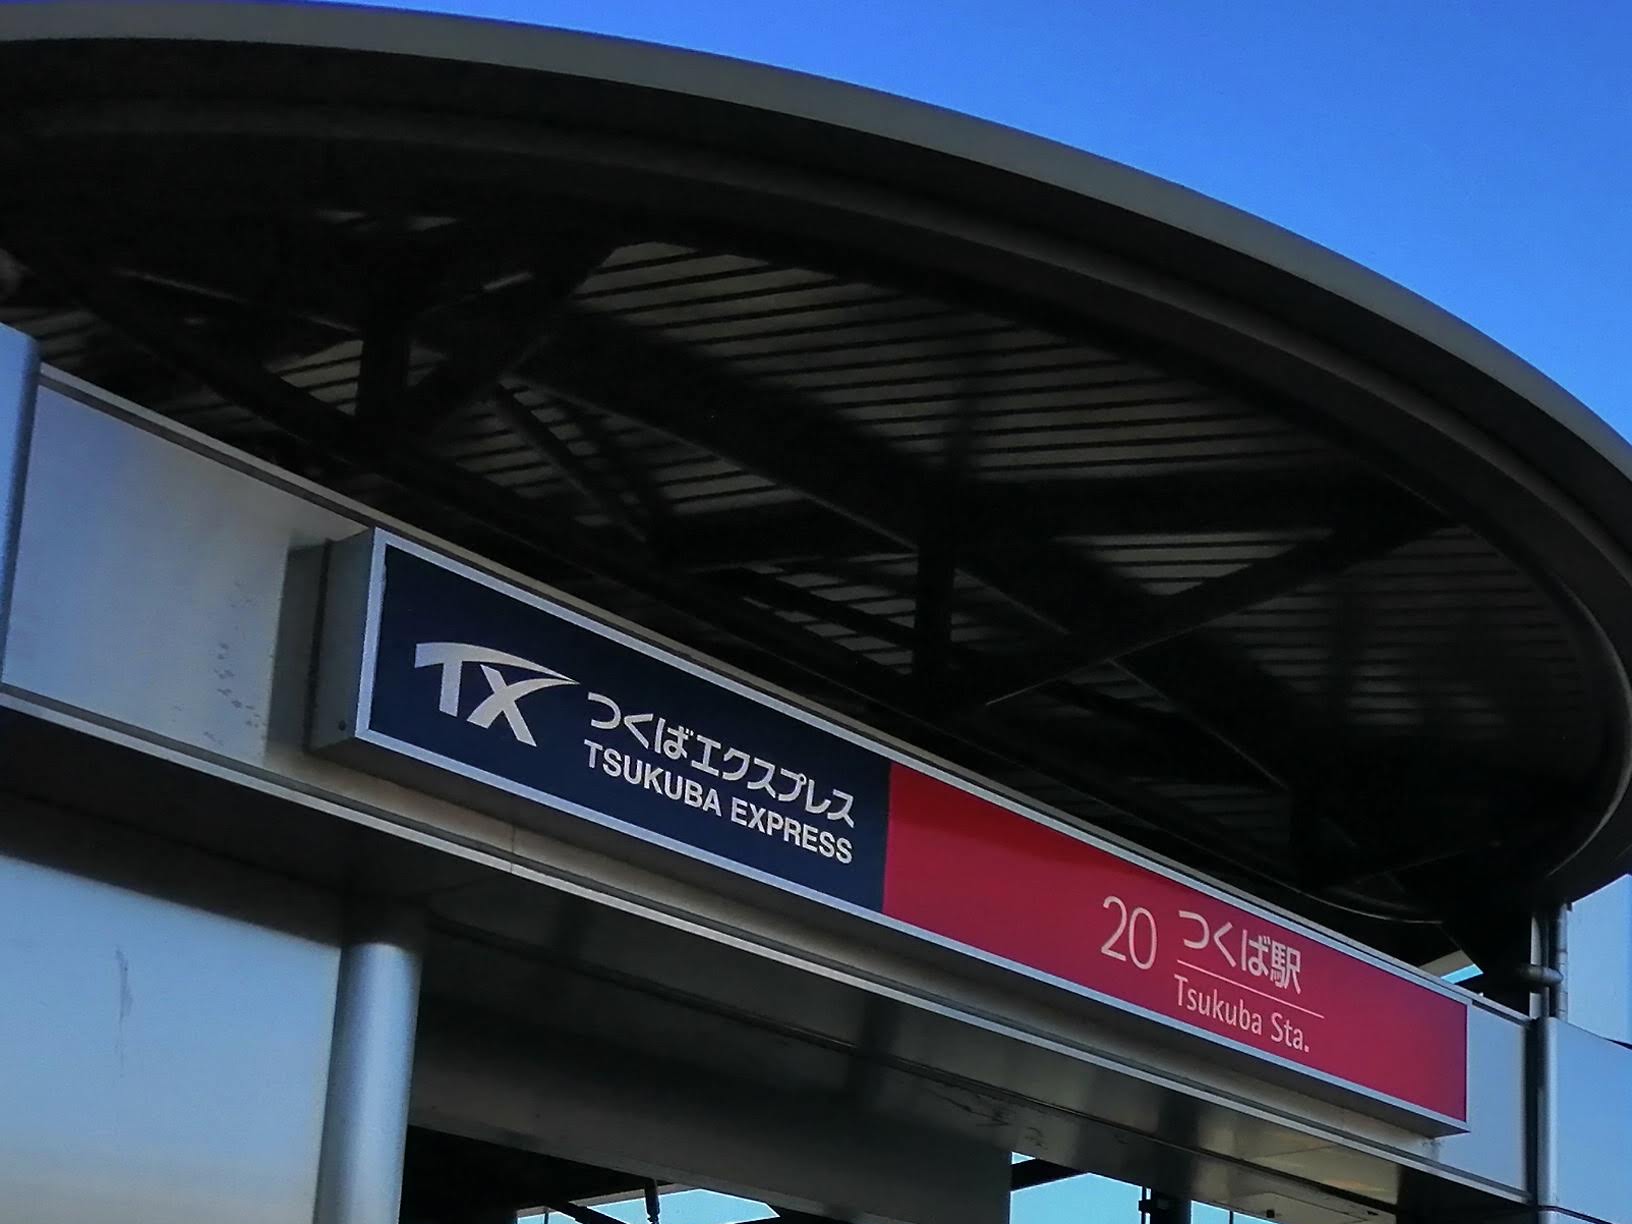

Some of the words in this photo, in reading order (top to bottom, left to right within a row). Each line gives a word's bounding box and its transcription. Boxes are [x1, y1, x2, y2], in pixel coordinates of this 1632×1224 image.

[414, 641, 581, 747] TX
[583, 738, 722, 817] TSUKUBA
[731, 795, 854, 865] EXPRESS
[587, 691, 856, 828] つくばエクスプレス
[1100, 894, 1158, 970] 20
[1177, 909, 1302, 995] つくば駅
[1173, 973, 1263, 1037] Tsukuba
[1270, 1012, 1310, 1053] Sta.
